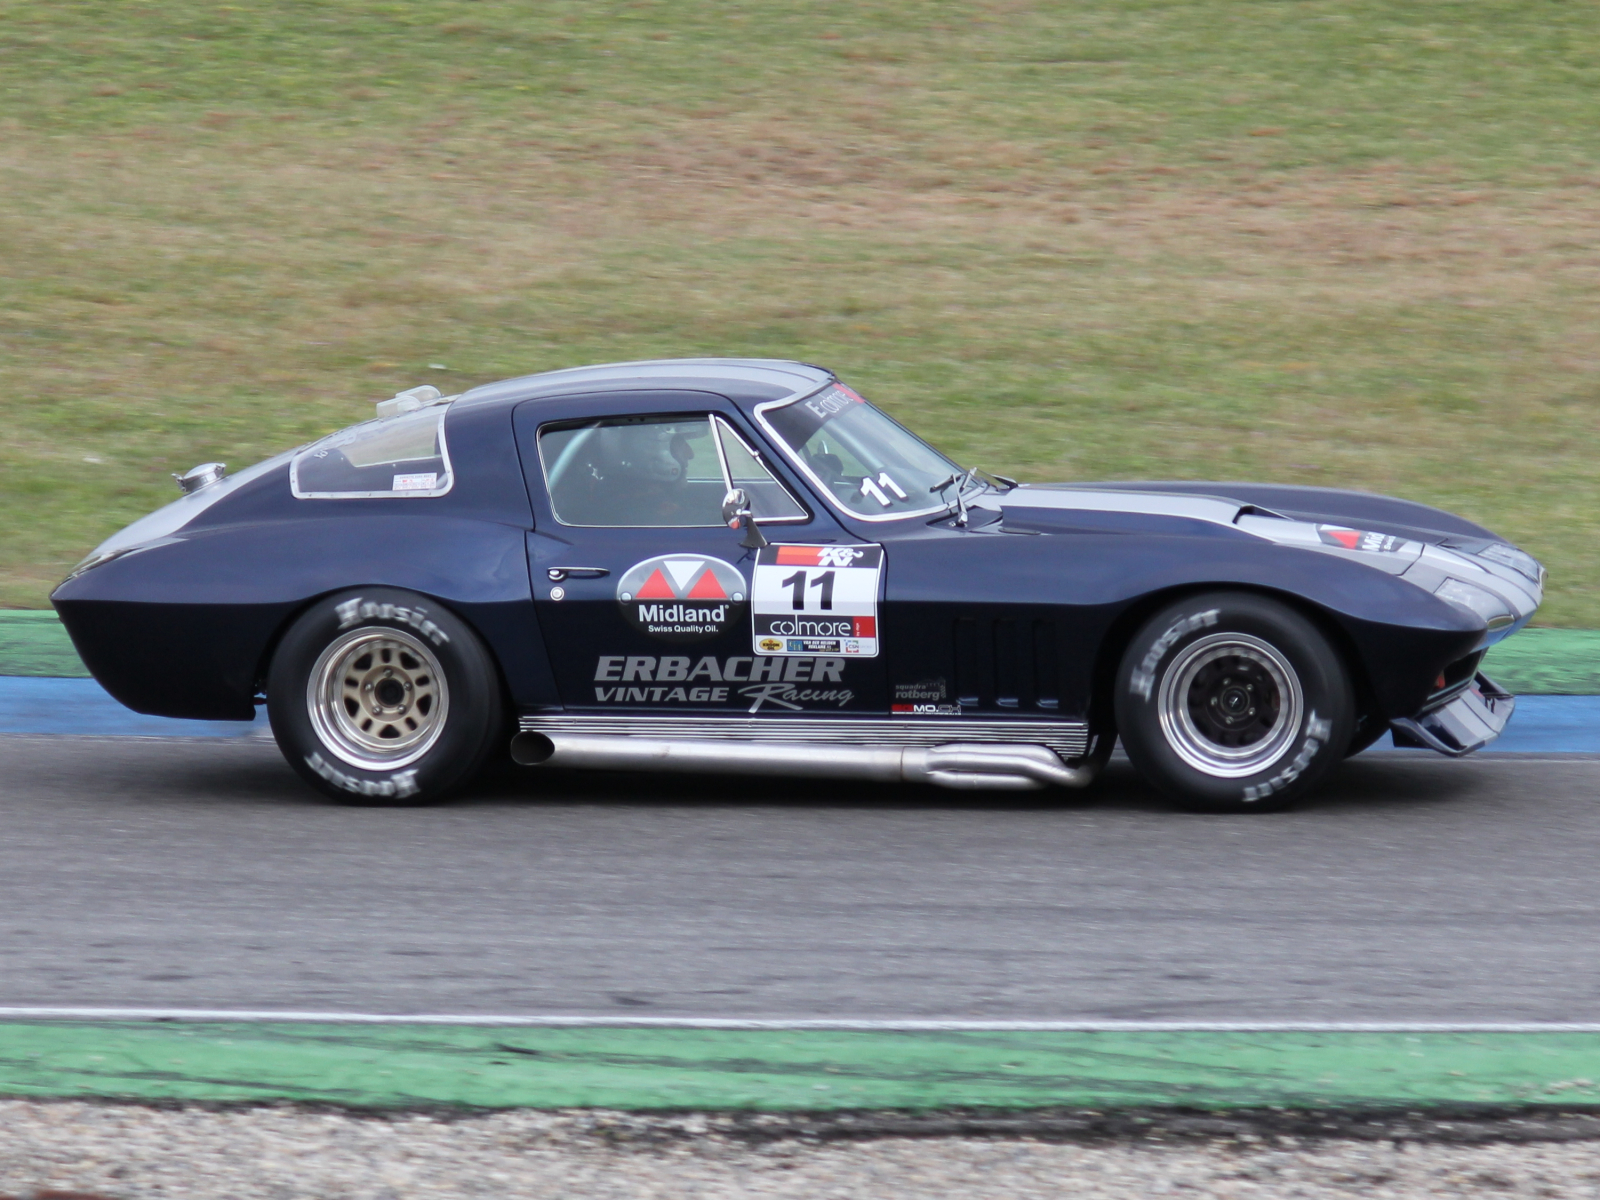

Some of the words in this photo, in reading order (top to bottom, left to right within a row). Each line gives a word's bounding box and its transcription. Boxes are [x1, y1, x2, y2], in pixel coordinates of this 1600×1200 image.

[860, 472, 908, 507] 11
[782, 570, 836, 611] 11
[638, 604, 725, 623] Midland
[770, 614, 852, 636] colmore
[648, 624, 673, 633] Swiss
[674, 624, 703, 634] Quality
[704, 624, 719, 633] Oil.
[593, 655, 846, 683] ERBACHER
[594, 686, 730, 702] VINTAGE
[737, 682, 855, 714] Racing
[895, 690, 940, 701] rotberg
